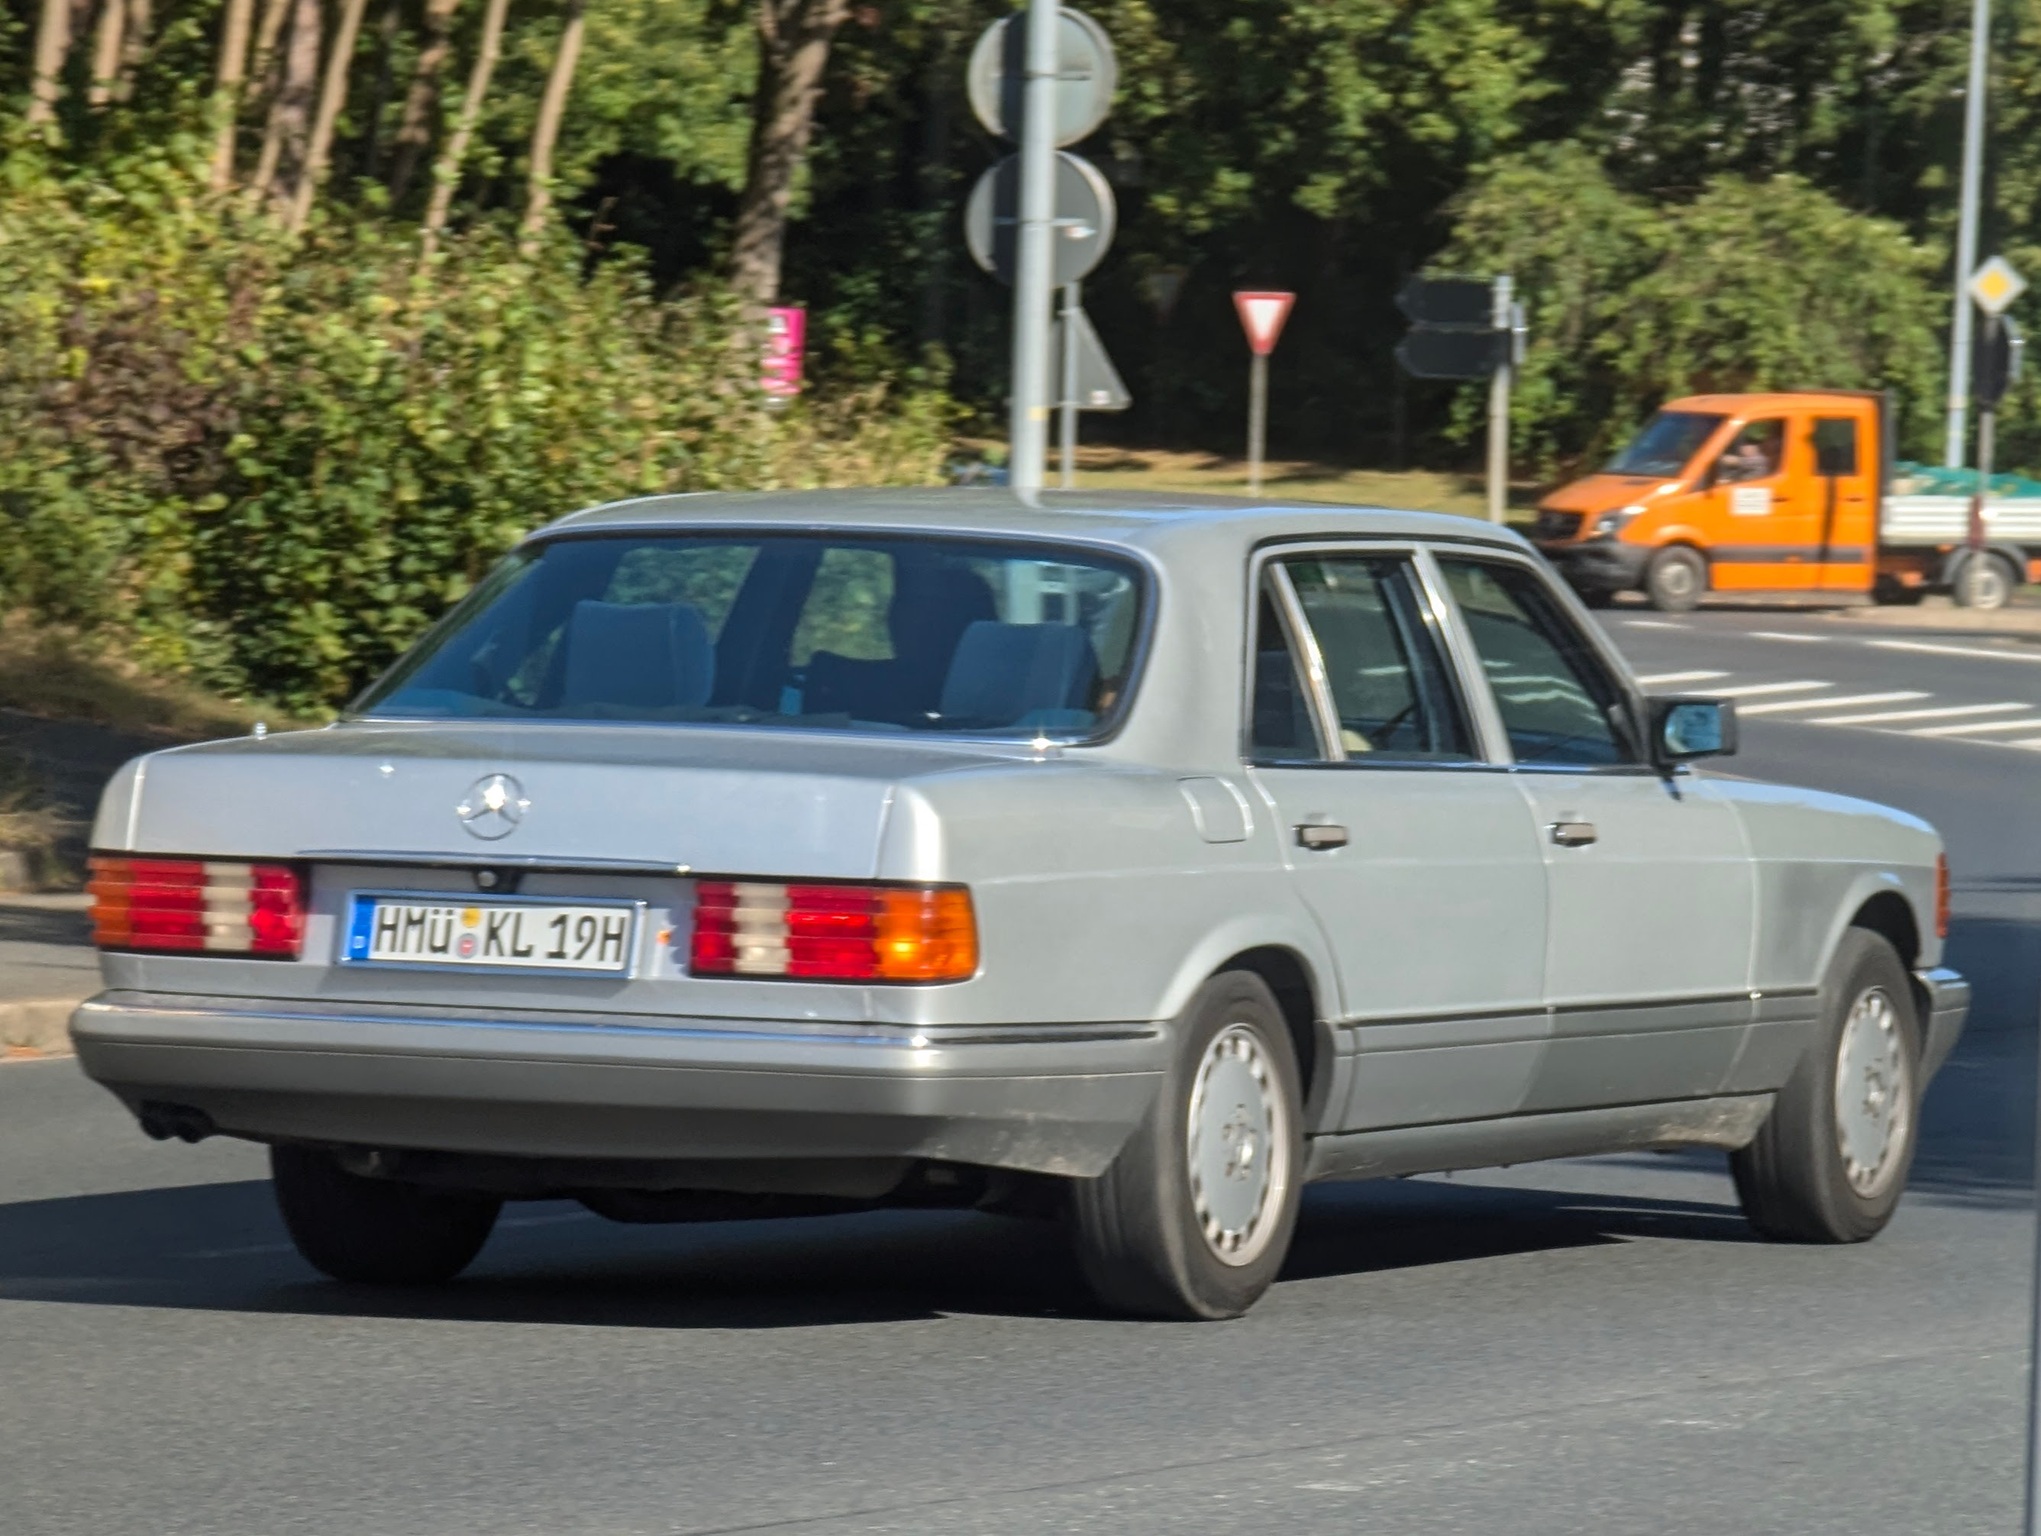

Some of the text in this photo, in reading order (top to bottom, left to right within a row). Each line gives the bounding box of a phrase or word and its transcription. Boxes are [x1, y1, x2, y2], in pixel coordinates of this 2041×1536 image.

[376, 906, 625, 962] HMÜ KL 19H
